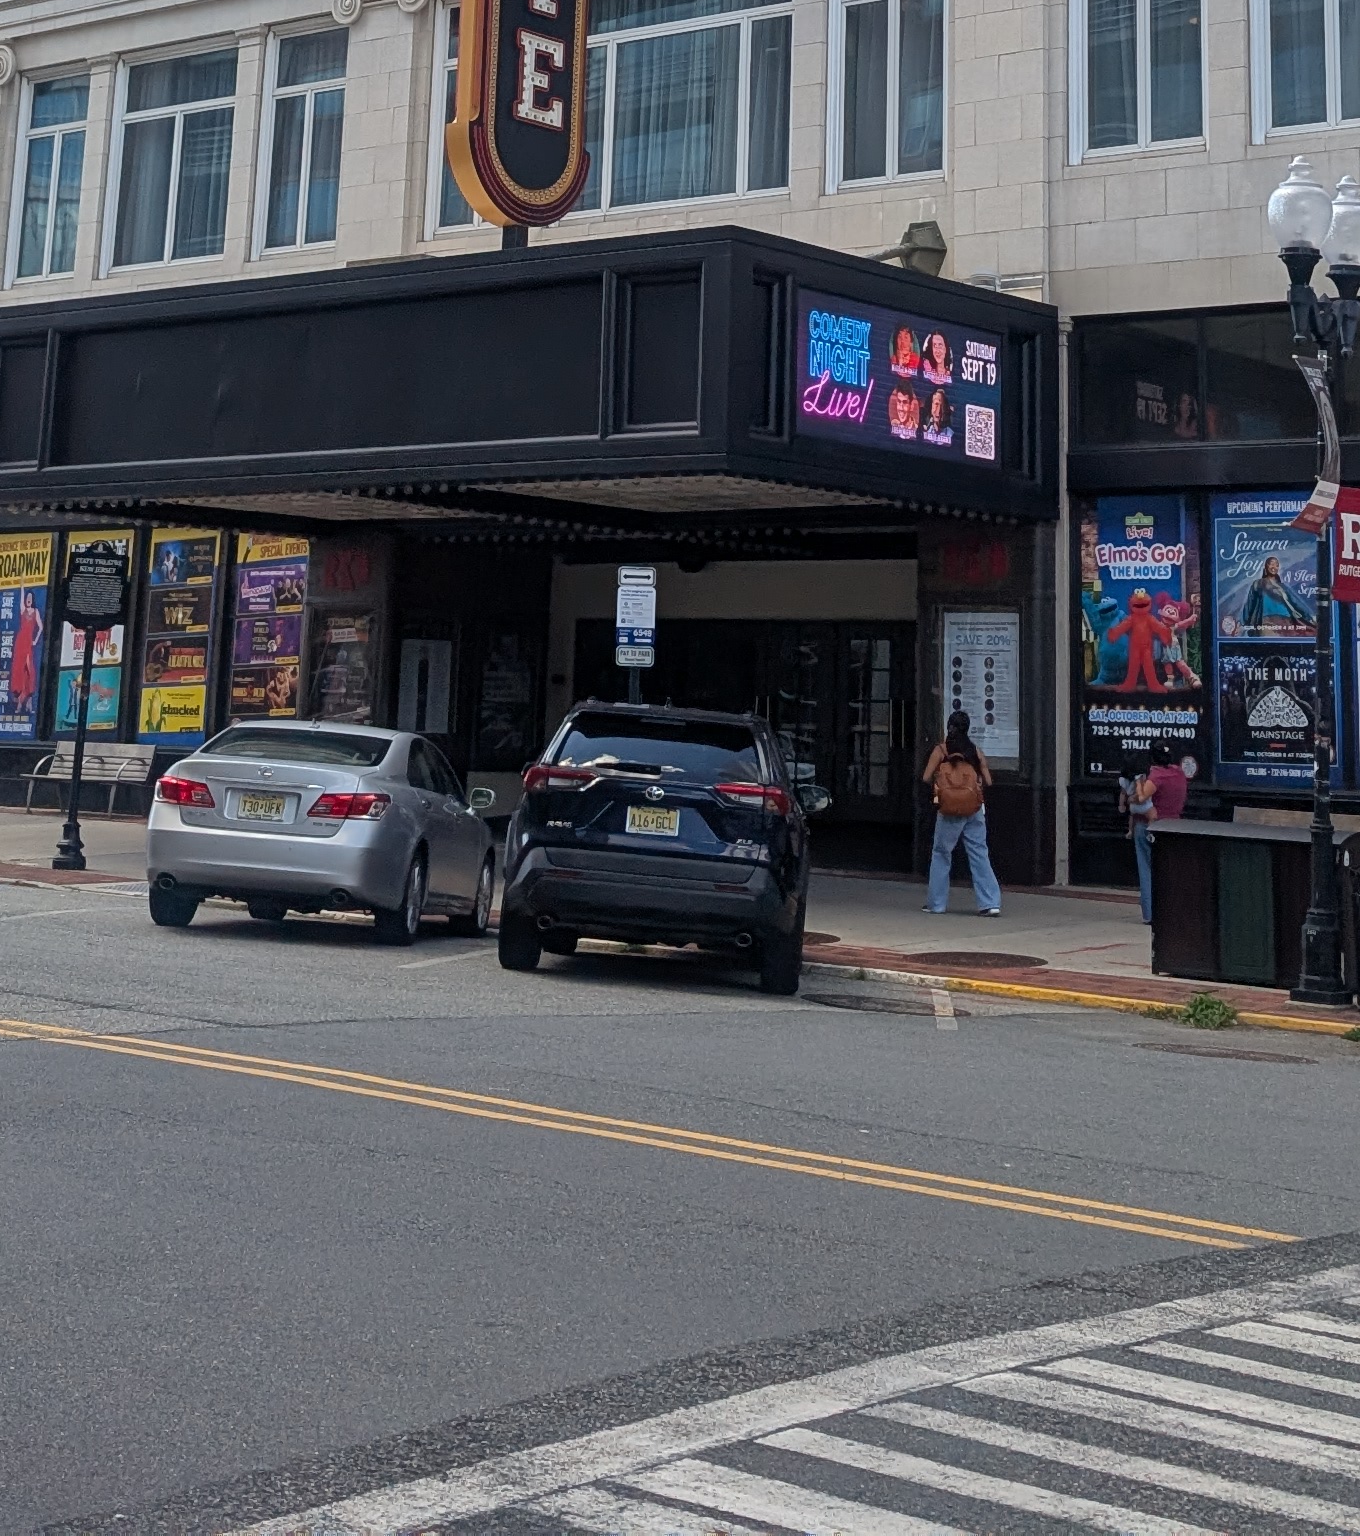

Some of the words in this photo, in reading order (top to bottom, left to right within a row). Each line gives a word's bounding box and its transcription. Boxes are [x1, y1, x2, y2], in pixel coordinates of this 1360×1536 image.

[809, 310, 871, 349] COMEDY
[966, 340, 996, 361] SATURDAY
[809, 339, 870, 387] NIGHT
[961, 357, 984, 383] SEPT
[986, 363, 997, 385] 19
[803, 370, 874, 422] Live!
[1227, 501, 1263, 514] UPCOMING
[19, 540, 29, 551] THE
[30, 539, 41, 550] BEST
[260, 544, 283, 559] SPECIAL
[284, 542, 308, 556] EVENTS
[1096, 541, 1148, 564] Elmo's
[1150, 544, 1184, 564] Got
[1220, 531, 1288, 560] Samara
[75, 557, 94, 565] STATE
[1226, 552, 1265, 578] Joy
[94, 566, 117, 574] JERSEY
[1111, 565, 1131, 578] THE
[1133, 565, 1170, 578] MOVES
[164, 607, 193, 624] WIZ
[955, 634, 983, 646] SAVE
[986, 635, 1010, 646] 20%
[1247, 667, 1269, 681] THE
[1274, 668, 1307, 682] MOTH
[162, 704, 200, 716] shucked
[1089, 709, 1109, 723] SAT,
[1108, 710, 1150, 723] OCTOBER
[1151, 710, 1163, 723] 10
[1164, 711, 1175, 723] AT
[1176, 711, 1198, 724] 2PM
[1092, 725, 1161, 737] 732-246-SHOW
[1251, 730, 1305, 740] MAINSTAGE
